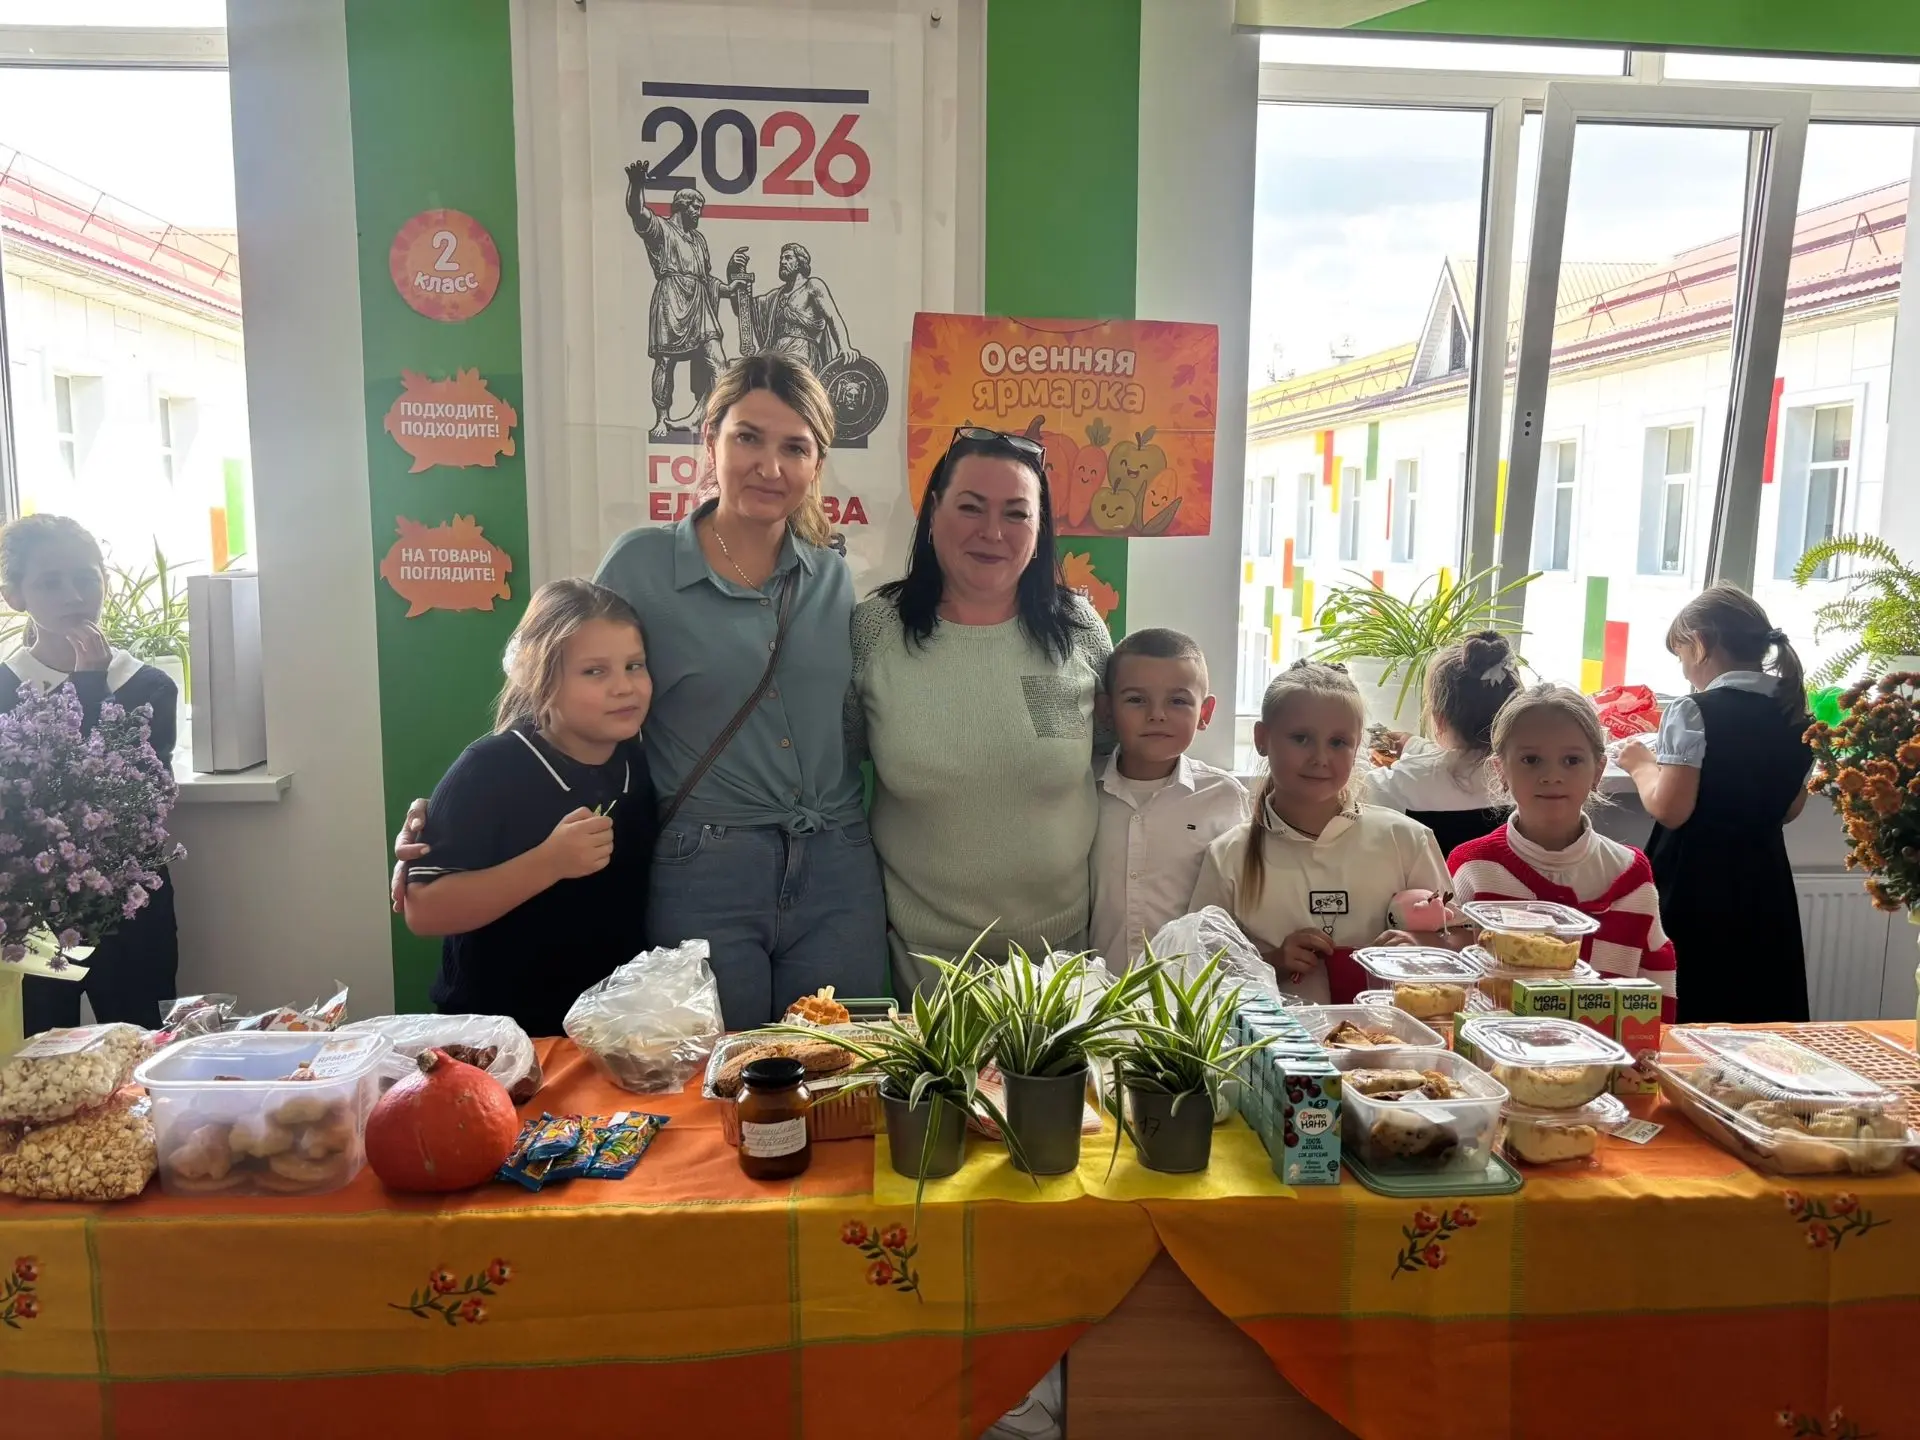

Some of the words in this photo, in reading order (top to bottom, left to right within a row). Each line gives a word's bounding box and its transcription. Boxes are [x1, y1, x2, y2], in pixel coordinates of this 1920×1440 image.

[641, 106, 871, 197] 2026
[431, 230, 460, 271] 2
[413, 271, 479, 294] класс
[981, 341, 1136, 377] Осенняя
[972, 378, 1145, 417] ярмарка
[400, 401, 499, 421] ПОДХОДИТЕ,
[400, 420, 500, 438] ПОДХОДИТЕ!
[648, 455, 698, 485] ГО
[649, 492, 869, 524] ЕДВА
[401, 548, 425, 562] НА
[428, 548, 492, 564] ТОВАРЫ
[400, 565, 496, 582] ПОГЛЯДИТЕ!
[1139, 1116, 1160, 1138] 17
